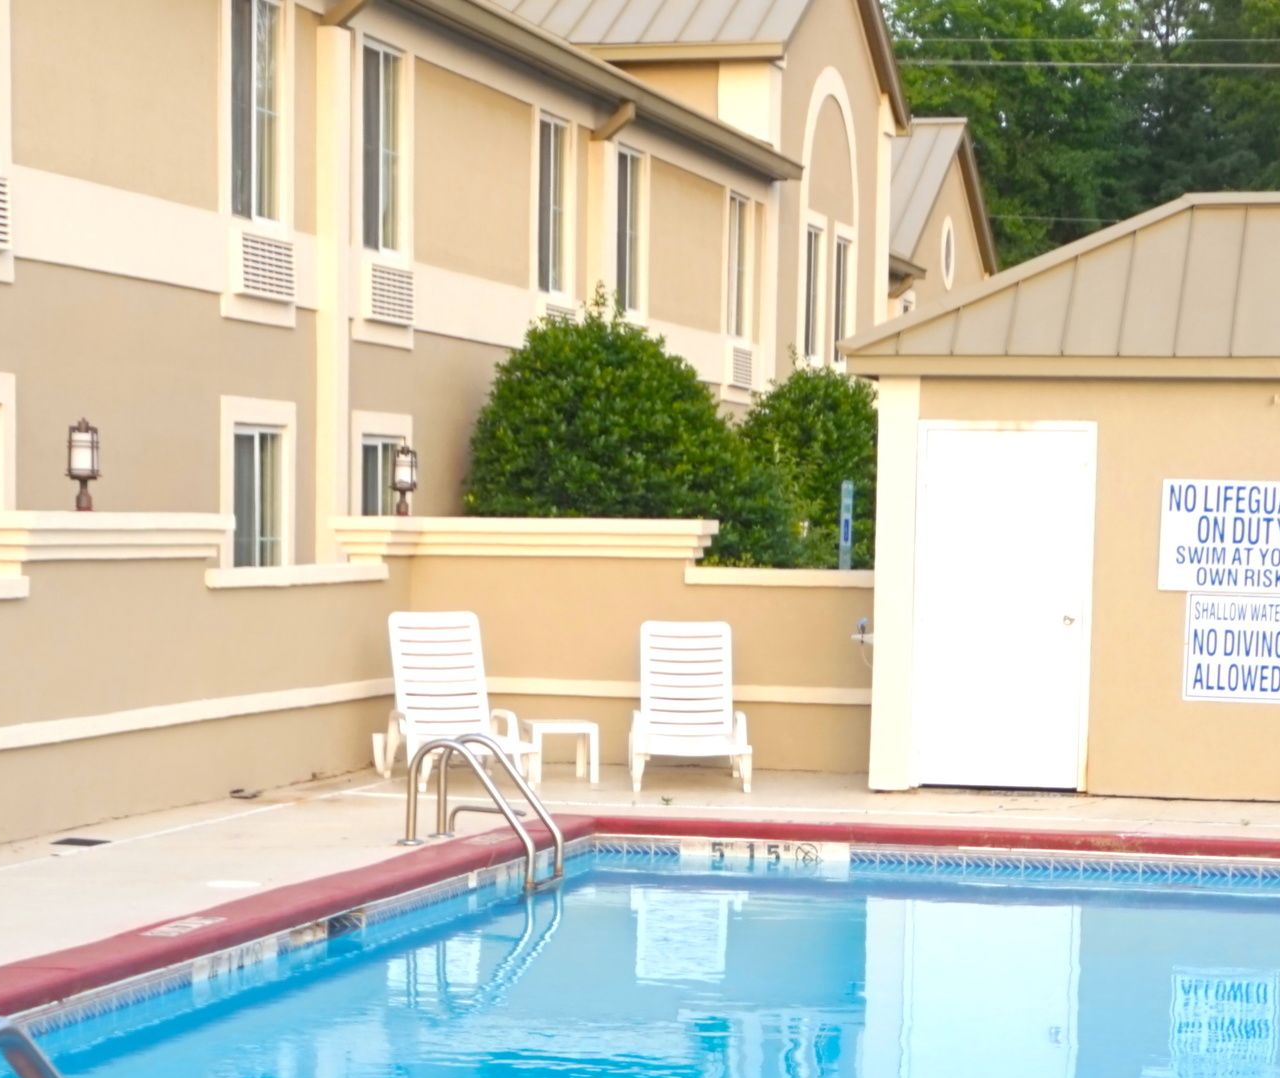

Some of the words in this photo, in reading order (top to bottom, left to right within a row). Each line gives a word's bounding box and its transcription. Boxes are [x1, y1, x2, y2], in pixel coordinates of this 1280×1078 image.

[1169, 484, 1197, 512] NO
[1197, 515, 1226, 544] ON
[1176, 545, 1226, 565] SWIM
[1231, 547, 1254, 566] AT
[1196, 567, 1239, 587] OWN
[1194, 601, 1248, 621] SHALLOW
[1193, 628, 1218, 656] NO
